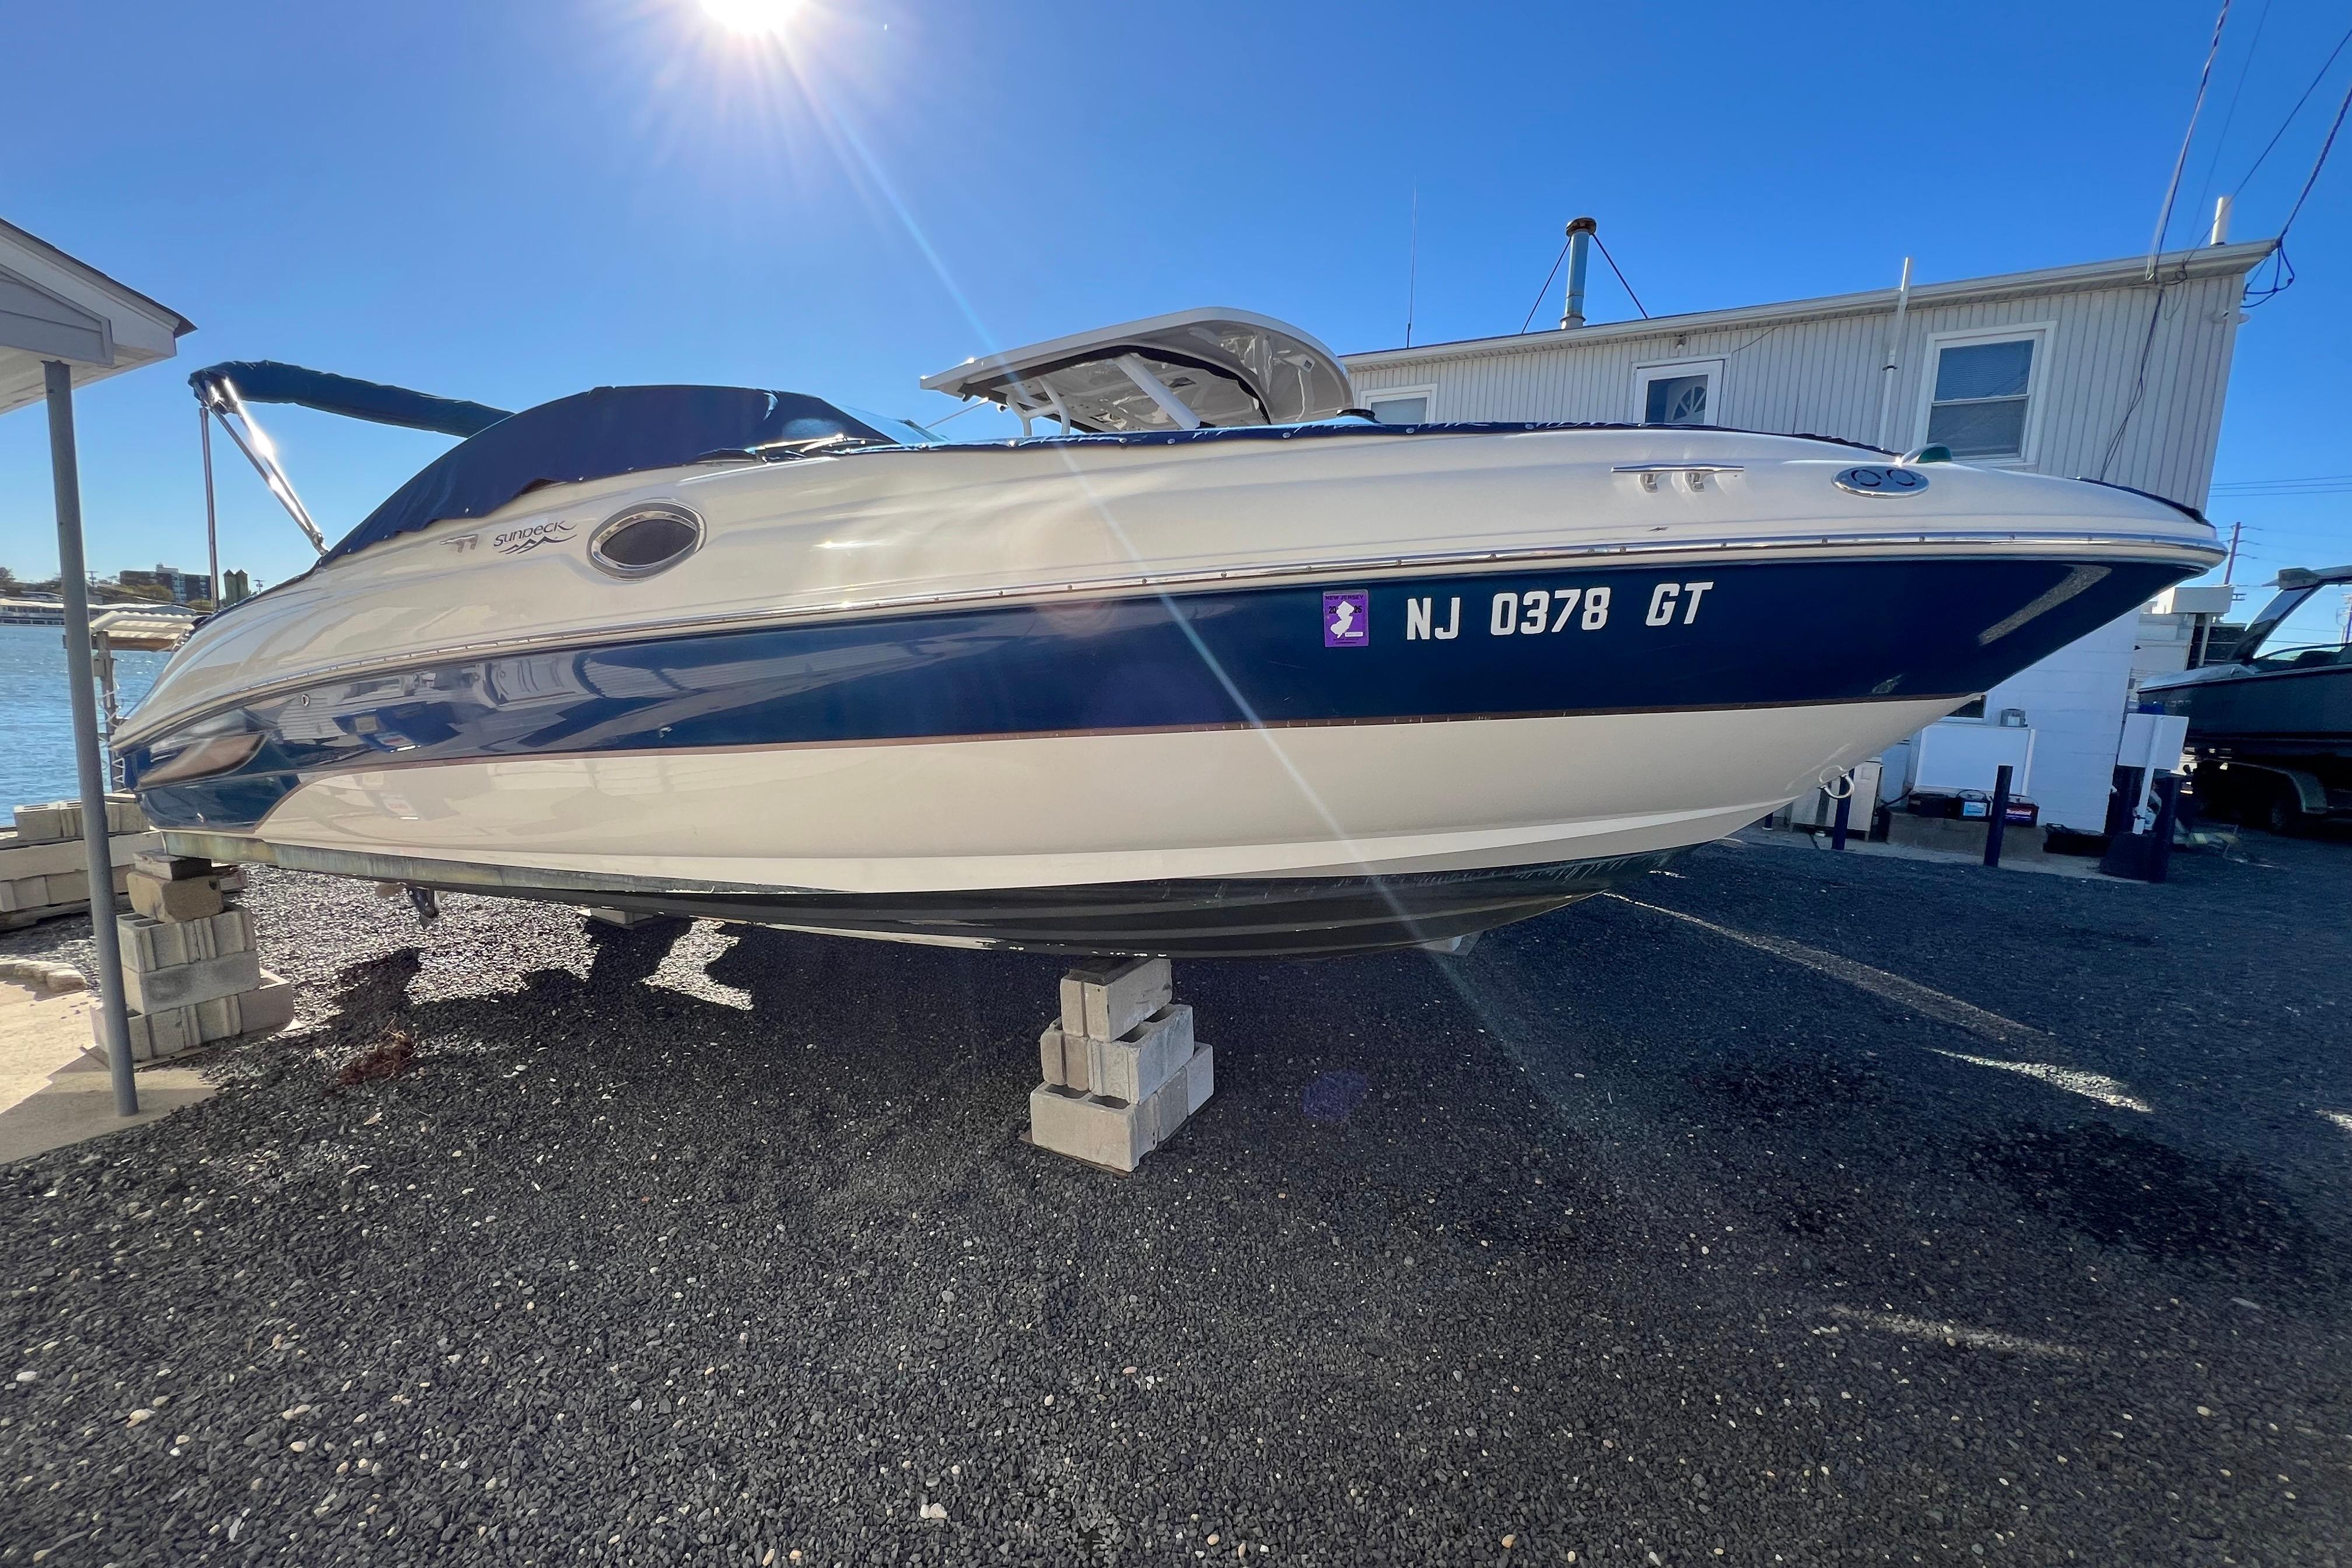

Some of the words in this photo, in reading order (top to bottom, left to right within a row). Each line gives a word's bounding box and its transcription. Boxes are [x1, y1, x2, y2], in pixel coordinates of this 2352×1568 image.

[1328, 606, 1337, 614] 20
[1407, 597, 1460, 640] NJ
[1491, 587, 1610, 635] 0378
[1646, 582, 1713, 626] GT
